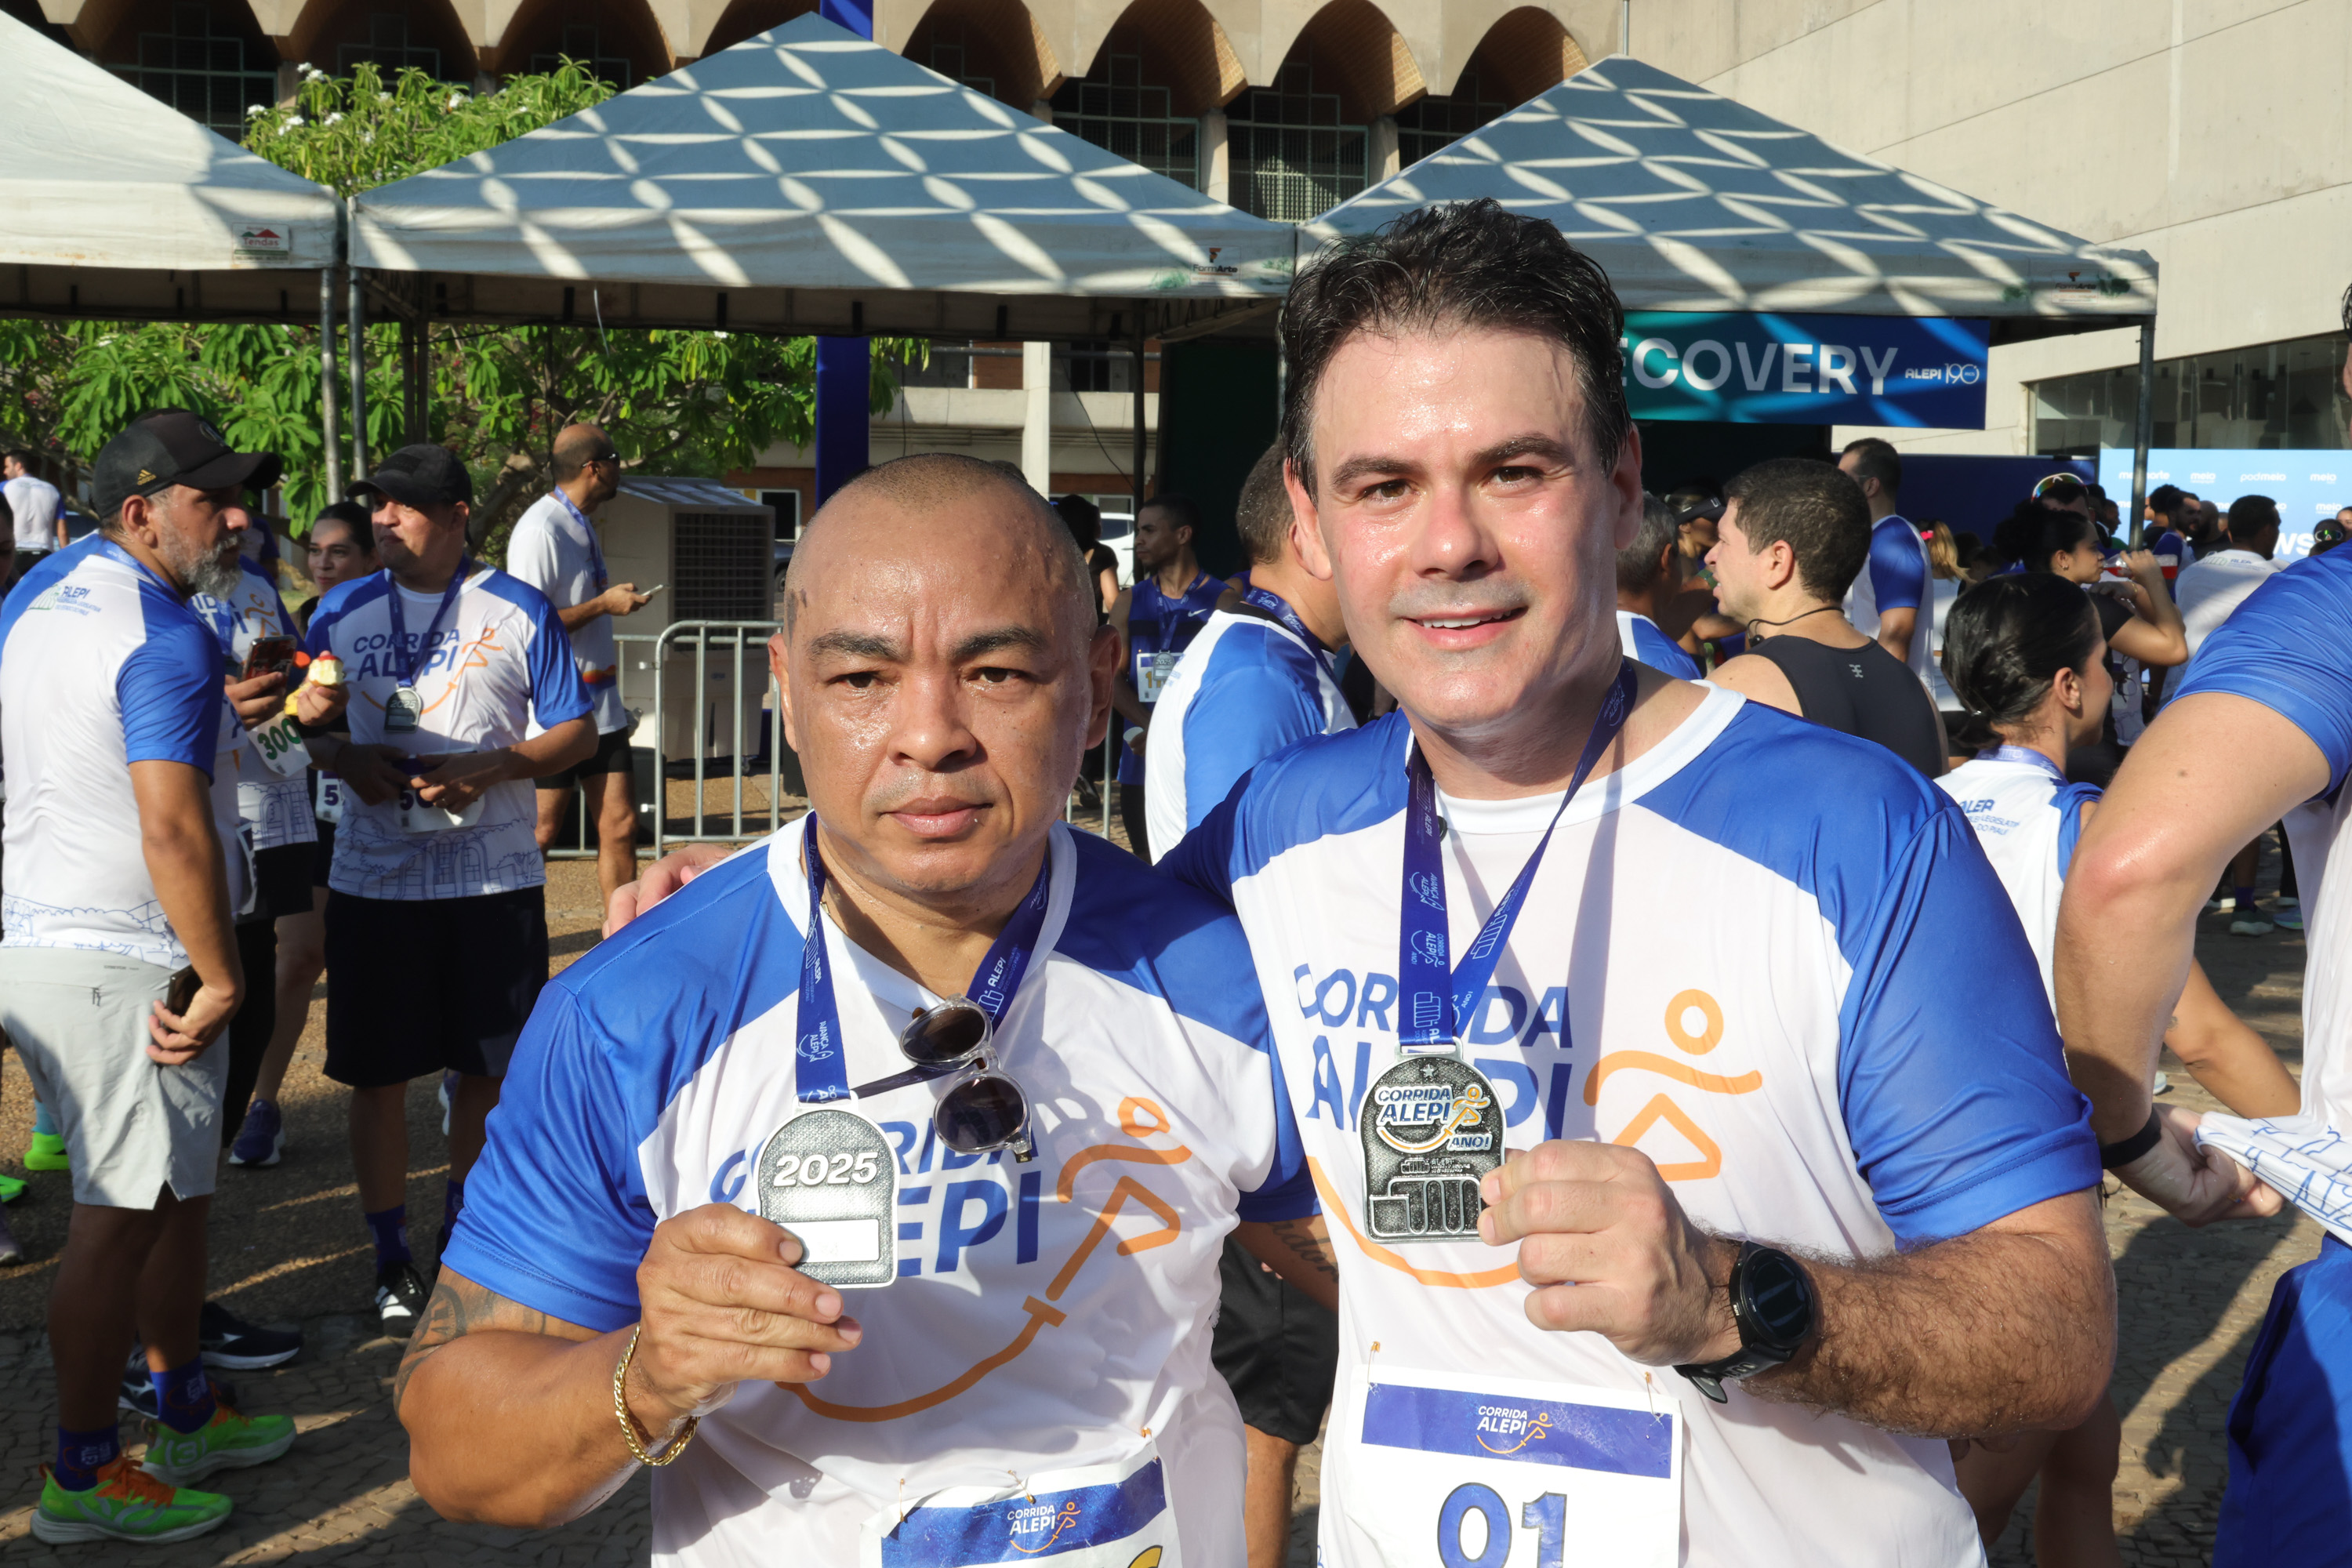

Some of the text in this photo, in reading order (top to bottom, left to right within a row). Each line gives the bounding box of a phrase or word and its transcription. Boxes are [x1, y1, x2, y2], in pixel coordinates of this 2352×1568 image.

[243, 237, 280, 246] Tendas
[1192, 264, 1238, 273] FormArte
[1905, 368, 1941, 379] ALEPI
[2240, 472, 2286, 481] podmeio
[2310, 473, 2336, 481] meio
[390, 700, 416, 709] 2025
[1426, 931, 1436, 957] ALEPI
[987, 956, 1007, 988] ALEPI
[1294, 963, 1573, 1049] CORDA
[810, 1034, 820, 1054] ALEPI
[1378, 1089, 1451, 1102] CORRIDA
[1381, 1102, 1450, 1123] ALEPI
[773, 1152, 878, 1187] 2025
[1479, 1405, 1528, 1420] CORRIDA
[1477, 1416, 1528, 1436] ALEPI
[1007, 1504, 1056, 1520] CORRIDA
[1009, 1515, 1056, 1535] ALEPI
[1436, 1482, 1568, 1568] 01
